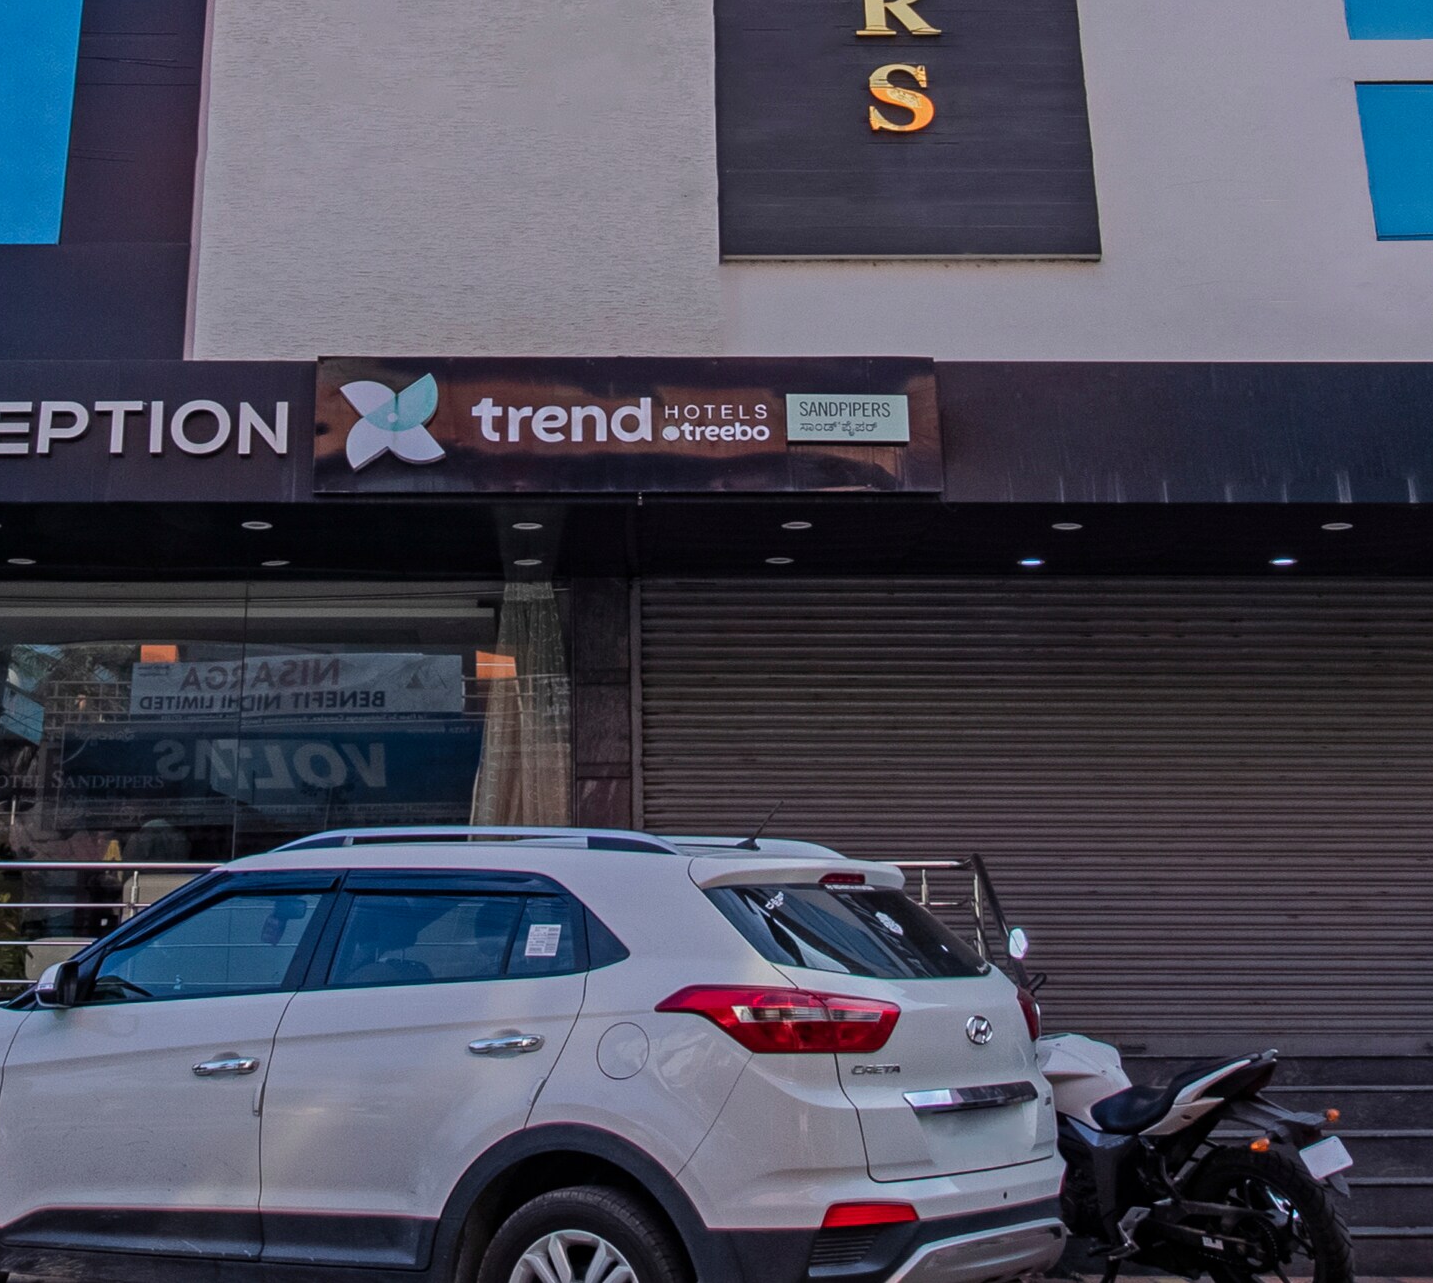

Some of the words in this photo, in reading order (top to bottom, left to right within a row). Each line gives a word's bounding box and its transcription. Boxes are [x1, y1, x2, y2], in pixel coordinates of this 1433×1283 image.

[665, 404, 768, 420] HOTELS
[799, 401, 891, 418] SANDPIPERS
[471, 397, 653, 442] trend
[51, 770, 165, 789] SANDPIPERS
